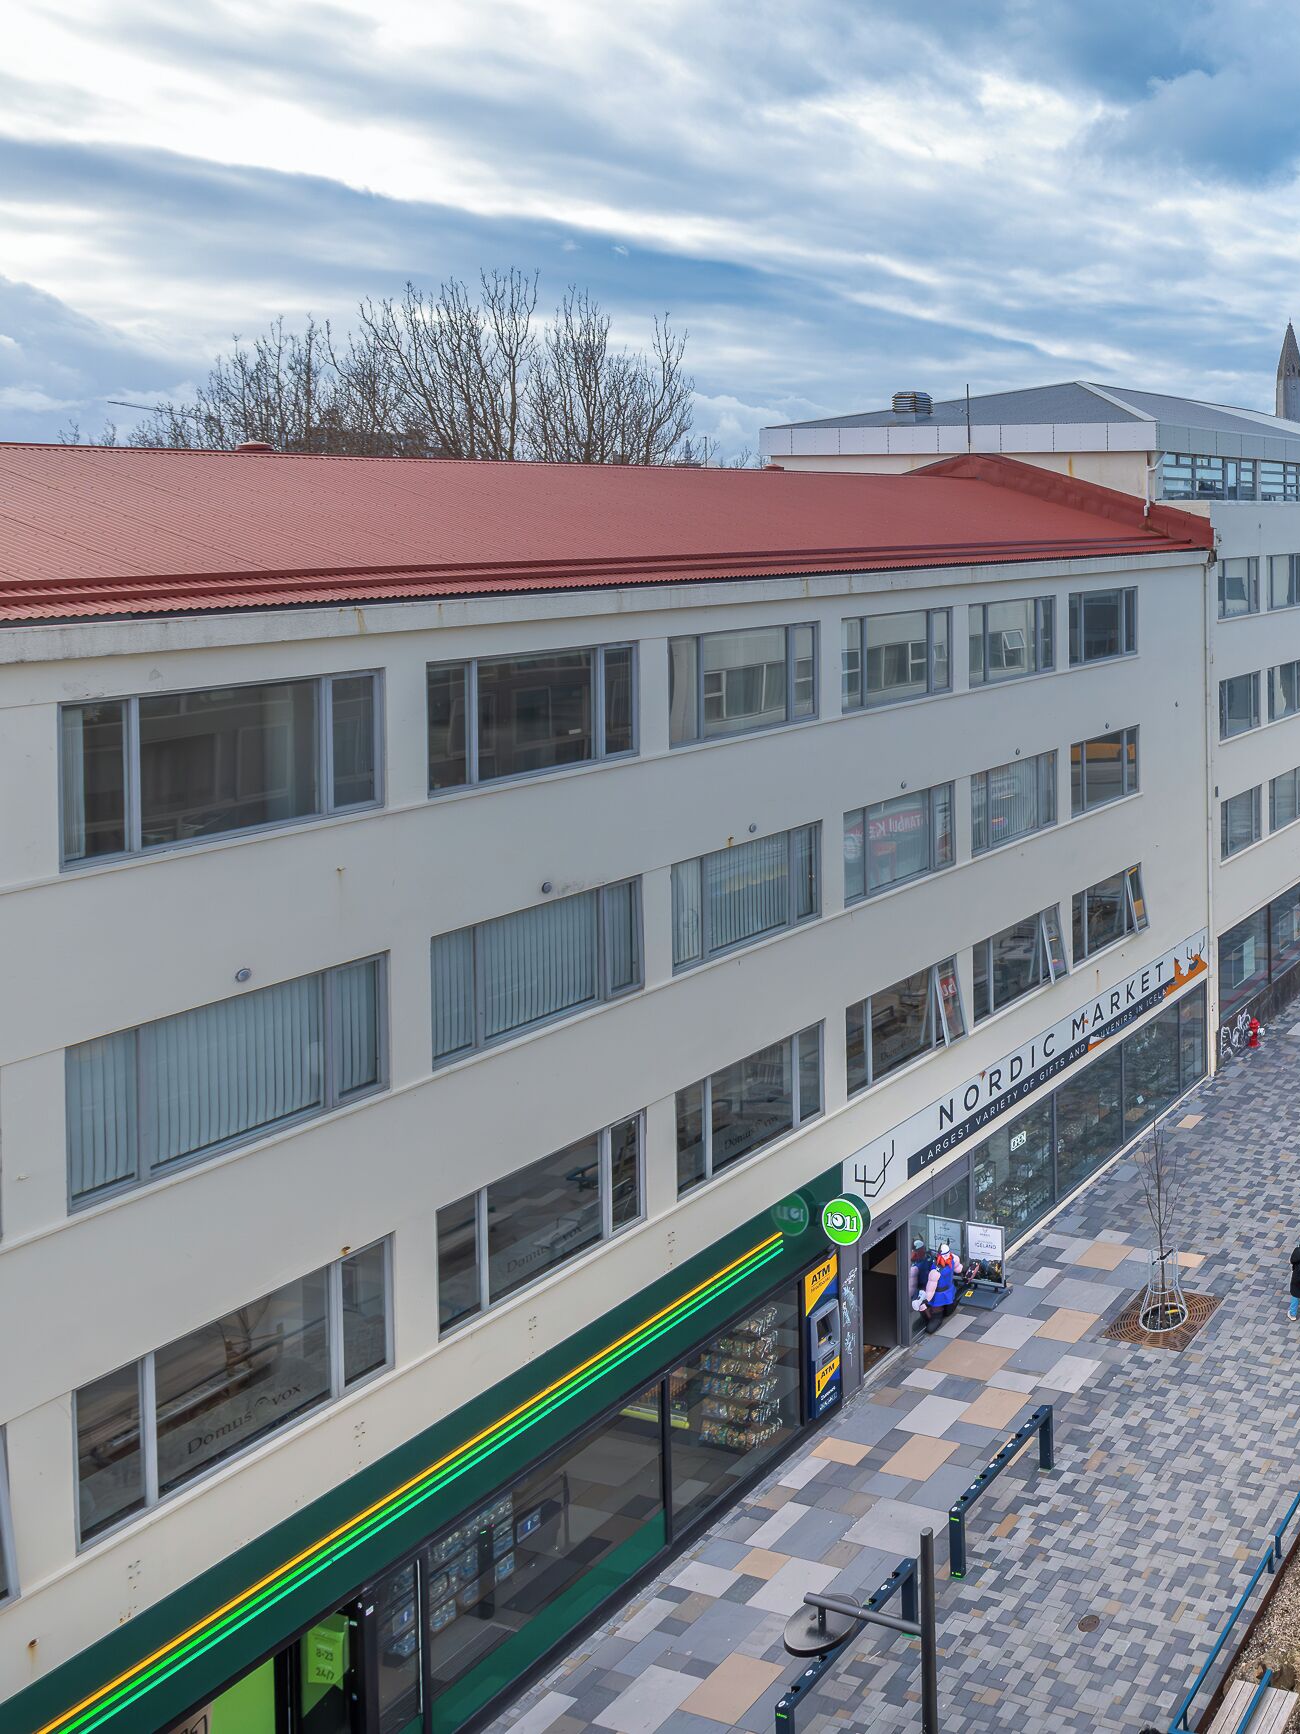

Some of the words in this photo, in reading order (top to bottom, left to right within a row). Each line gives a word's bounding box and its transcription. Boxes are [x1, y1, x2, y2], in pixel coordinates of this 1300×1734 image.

[940, 1033, 1055, 1130] NORDIC
[1072, 961, 1163, 1040] MARKET
[920, 1124, 970, 1165] LARGEST
[975, 1090, 1018, 1125] VARIETY
[1023, 1079, 1034, 1092] OF
[1040, 1057, 1065, 1081] GIFTS
[1069, 1043, 1086, 1061] AND
[1136, 1003, 1143, 1014] IN
[1146, 987, 1167, 1007] ICELA
[1011, 1132, 1025, 1149] OPEN
[975, 1242, 997, 1250] ICELAND
[811, 1263, 831, 1285] ATM
[820, 1362, 835, 1380] ATM
[187, 1410, 253, 1454] Domus
[315, 1666, 335, 1681] 24/7
